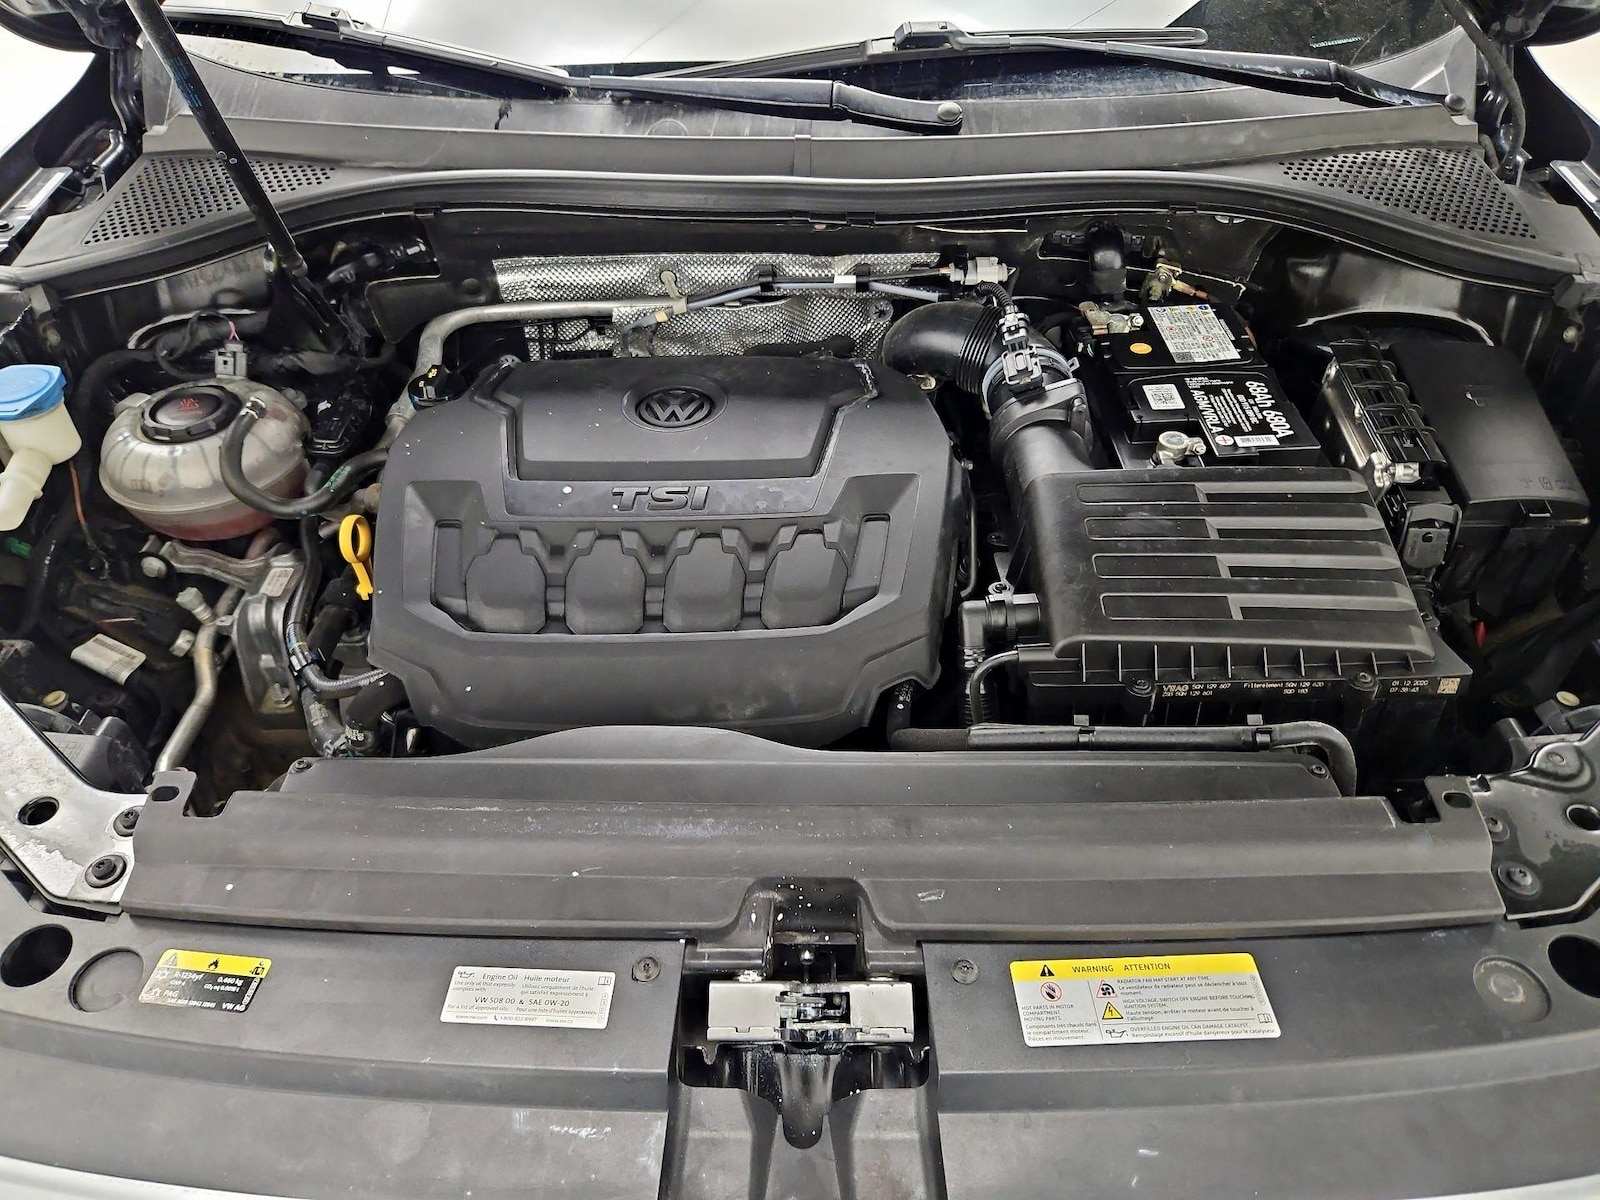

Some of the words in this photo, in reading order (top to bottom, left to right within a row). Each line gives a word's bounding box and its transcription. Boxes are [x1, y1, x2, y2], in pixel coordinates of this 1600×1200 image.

[1245, 381, 1275, 408] 68Ah
[1262, 409, 1294, 438] 680A
[612, 486, 710, 511] TSI
[1072, 965, 1114, 973] WARNING
[1124, 963, 1171, 971] ATTENTION
[174, 971, 204, 981] R-1234yf
[482, 973, 506, 981] Engine
[235, 978, 244, 986] kg
[163, 989, 179, 998] PAG
[222, 1002, 235, 1010] VW
